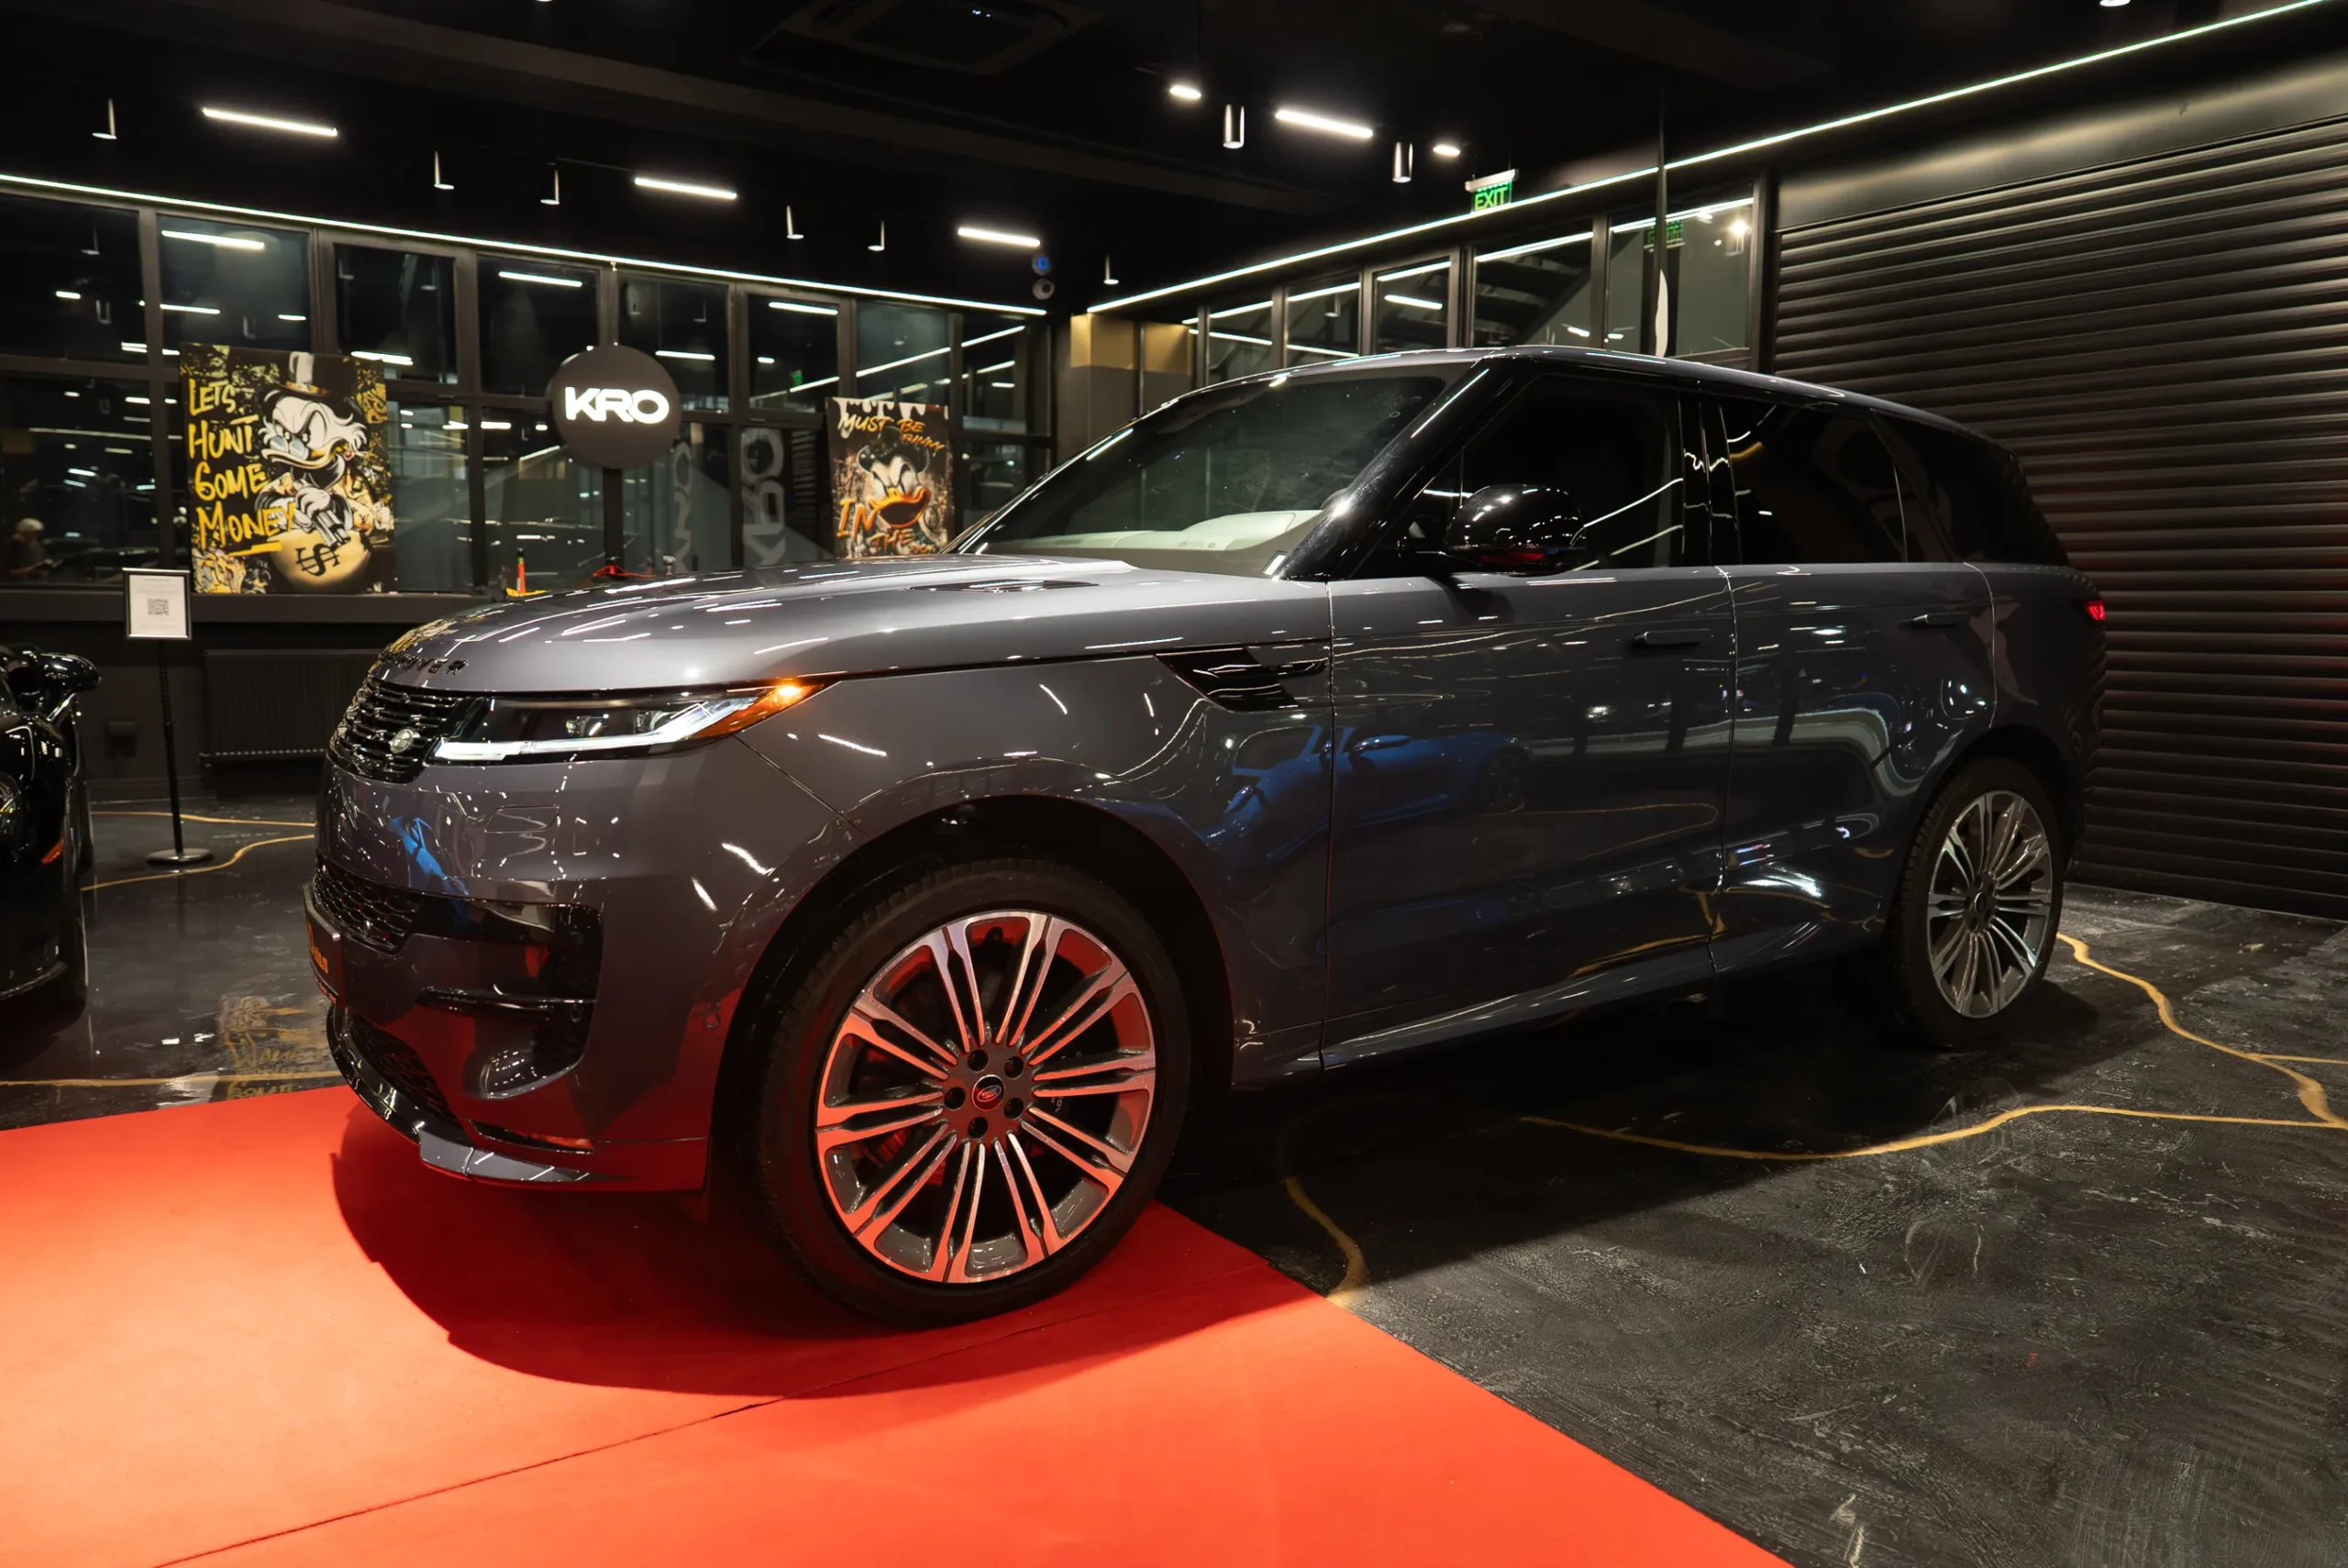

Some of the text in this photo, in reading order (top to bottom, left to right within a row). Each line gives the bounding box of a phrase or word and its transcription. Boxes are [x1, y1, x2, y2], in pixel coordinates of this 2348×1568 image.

[1474, 186, 1509, 211] EXIT
[188, 378, 236, 416] LETS
[564, 386, 670, 425] KRO
[188, 414, 260, 459] HUNT
[837, 413, 926, 435] MUST BE
[196, 501, 295, 551] MONEY
[836, 497, 879, 541] IN
[865, 527, 915, 553] THE
[294, 542, 340, 577] $
